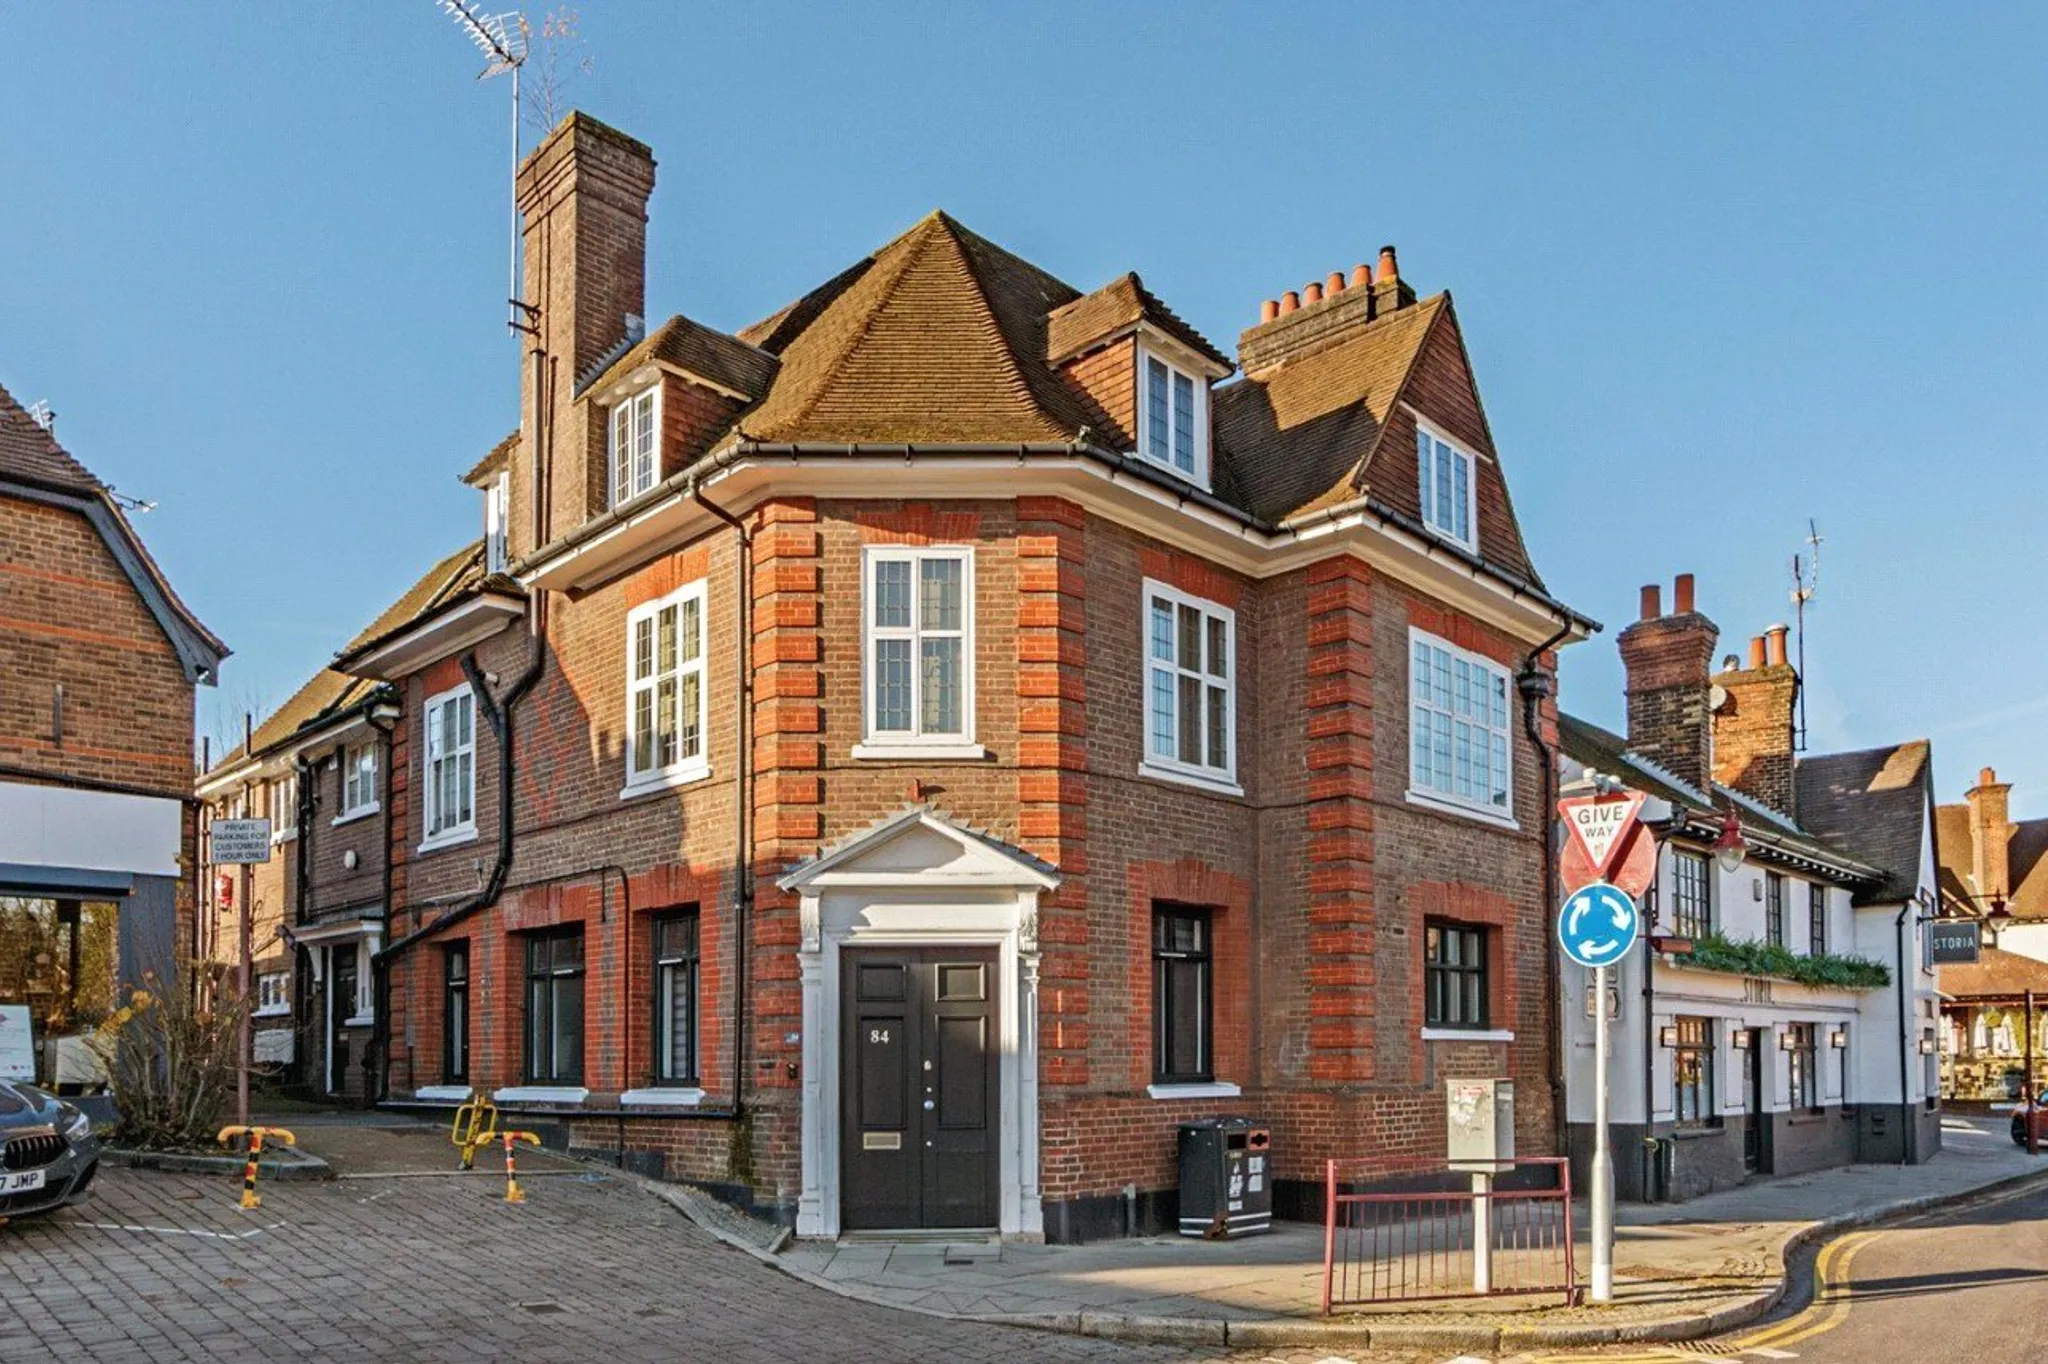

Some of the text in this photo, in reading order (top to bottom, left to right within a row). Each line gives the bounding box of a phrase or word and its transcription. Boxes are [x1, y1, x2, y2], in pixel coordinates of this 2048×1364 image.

[1577, 805, 1624, 824] GIVE
[1585, 826, 1614, 837] WAY
[1934, 937, 1974, 950] STORIA
[871, 1029, 889, 1044] 84
[11, 1172, 38, 1189] JMP
